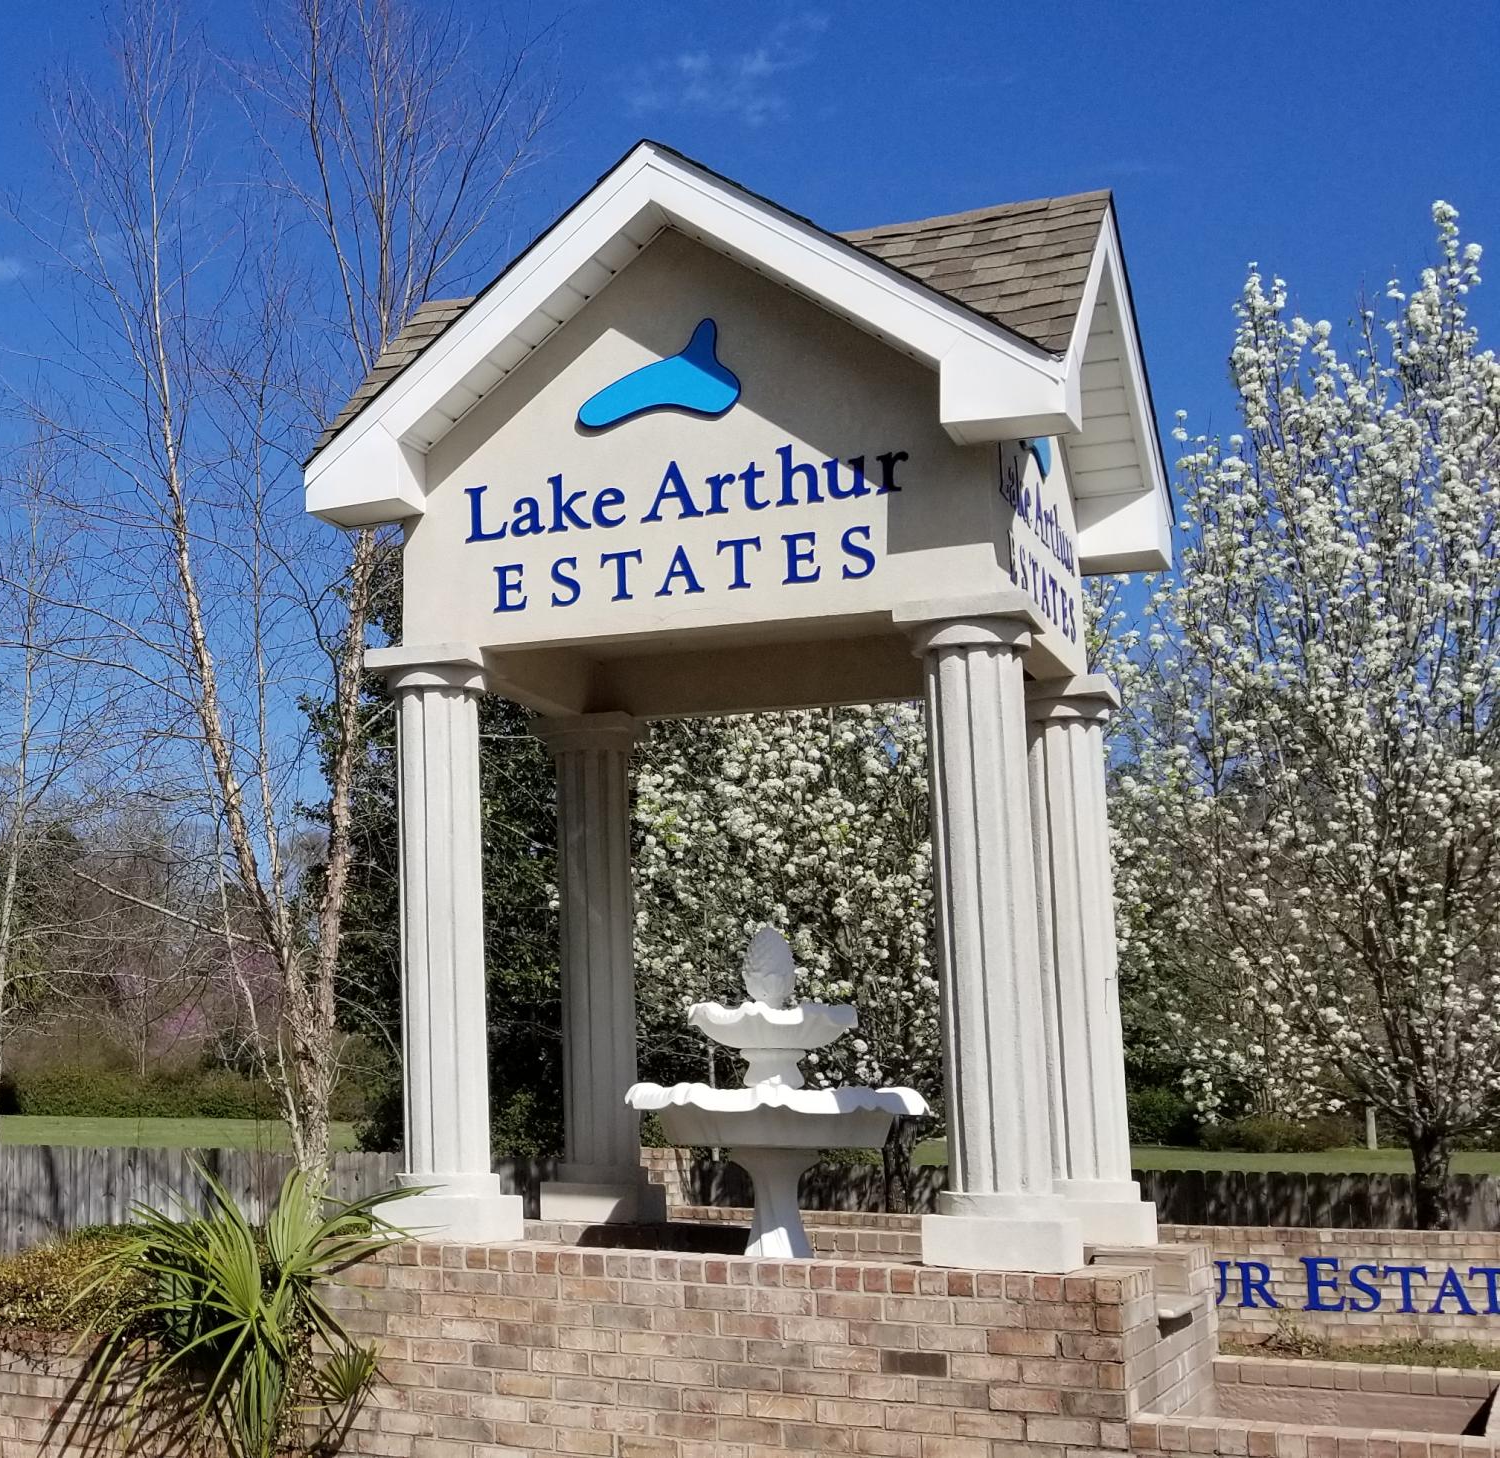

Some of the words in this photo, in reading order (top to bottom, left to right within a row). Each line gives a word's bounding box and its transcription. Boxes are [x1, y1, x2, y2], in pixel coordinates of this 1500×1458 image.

[463, 472, 626, 544] Lake
[640, 443, 909, 525] Arthur
[1034, 481, 1075, 577] Arthur
[493, 525, 877, 614] ESTATES
[1007, 529, 1077, 644] ESTATES
